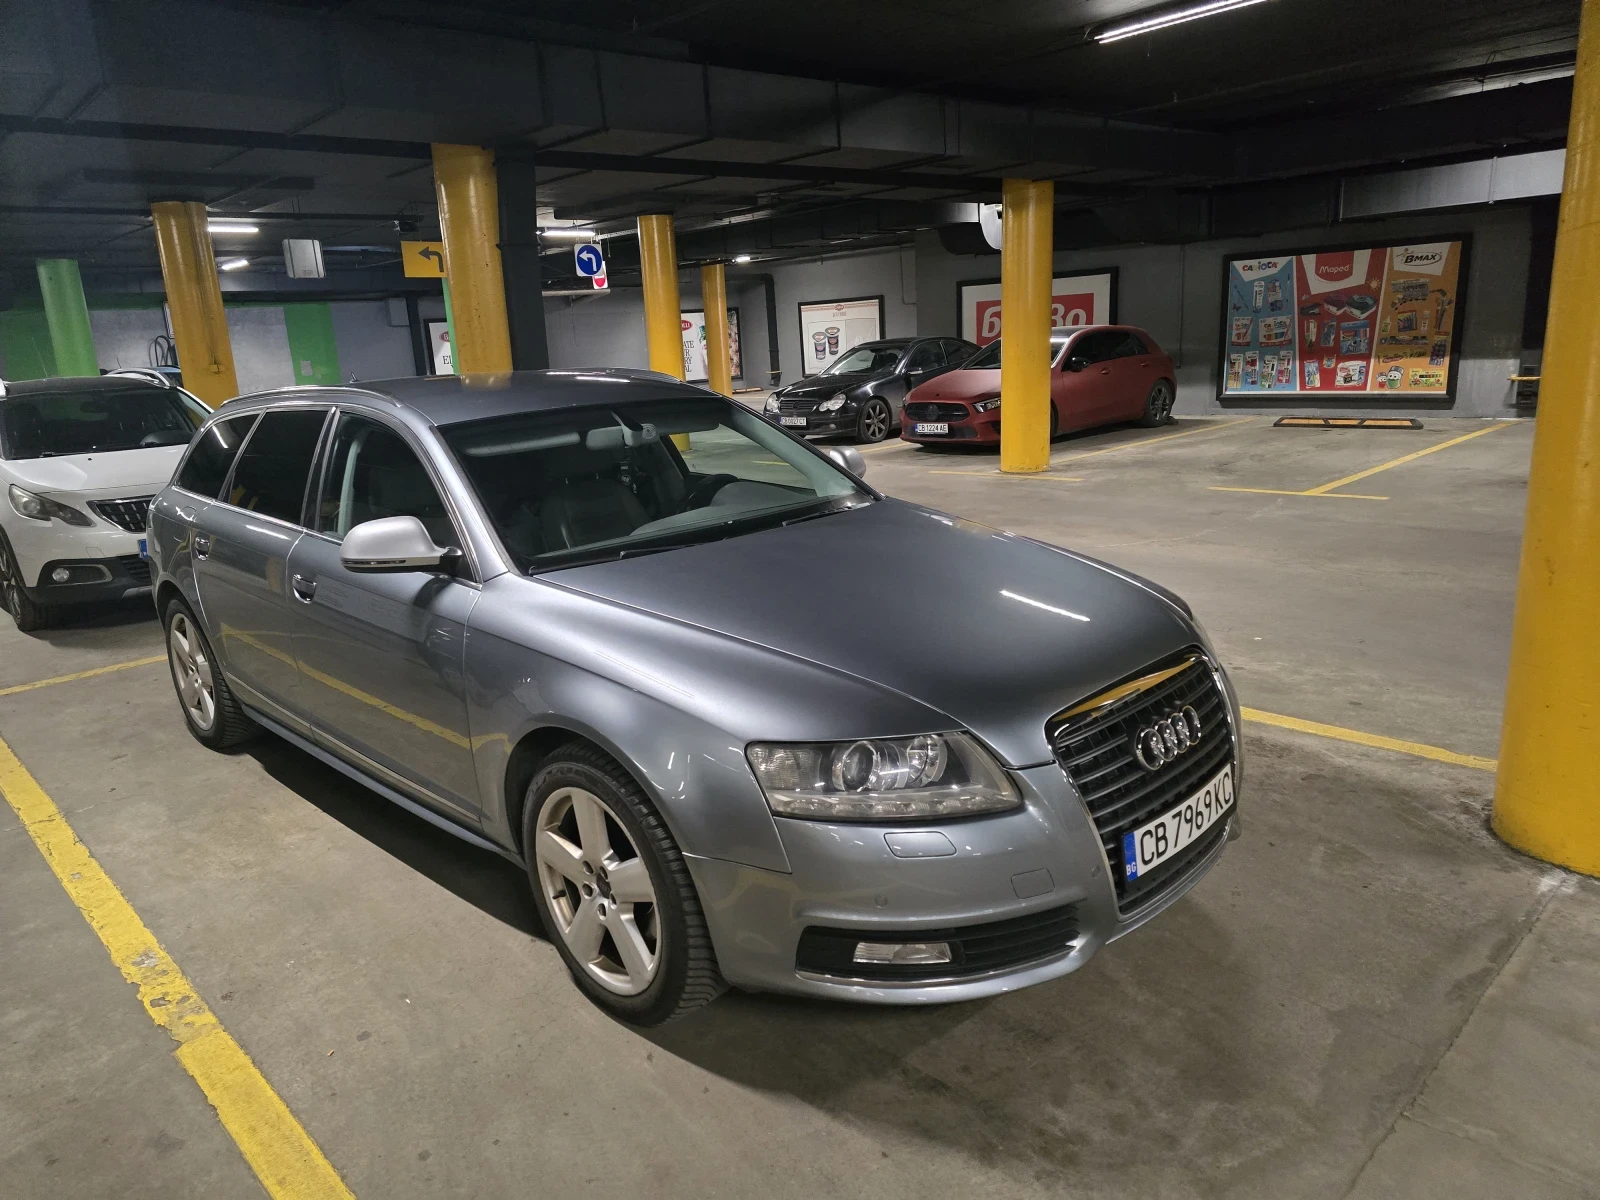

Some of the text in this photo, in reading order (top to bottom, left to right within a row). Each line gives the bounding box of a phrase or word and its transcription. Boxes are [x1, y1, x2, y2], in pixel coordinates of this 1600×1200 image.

[1404, 252, 1437, 264] BMAX
[1318, 264, 1350, 275] Maped
[1140, 771, 1232, 866] CB 7969 KC
[1126, 862, 1137, 876] BG
